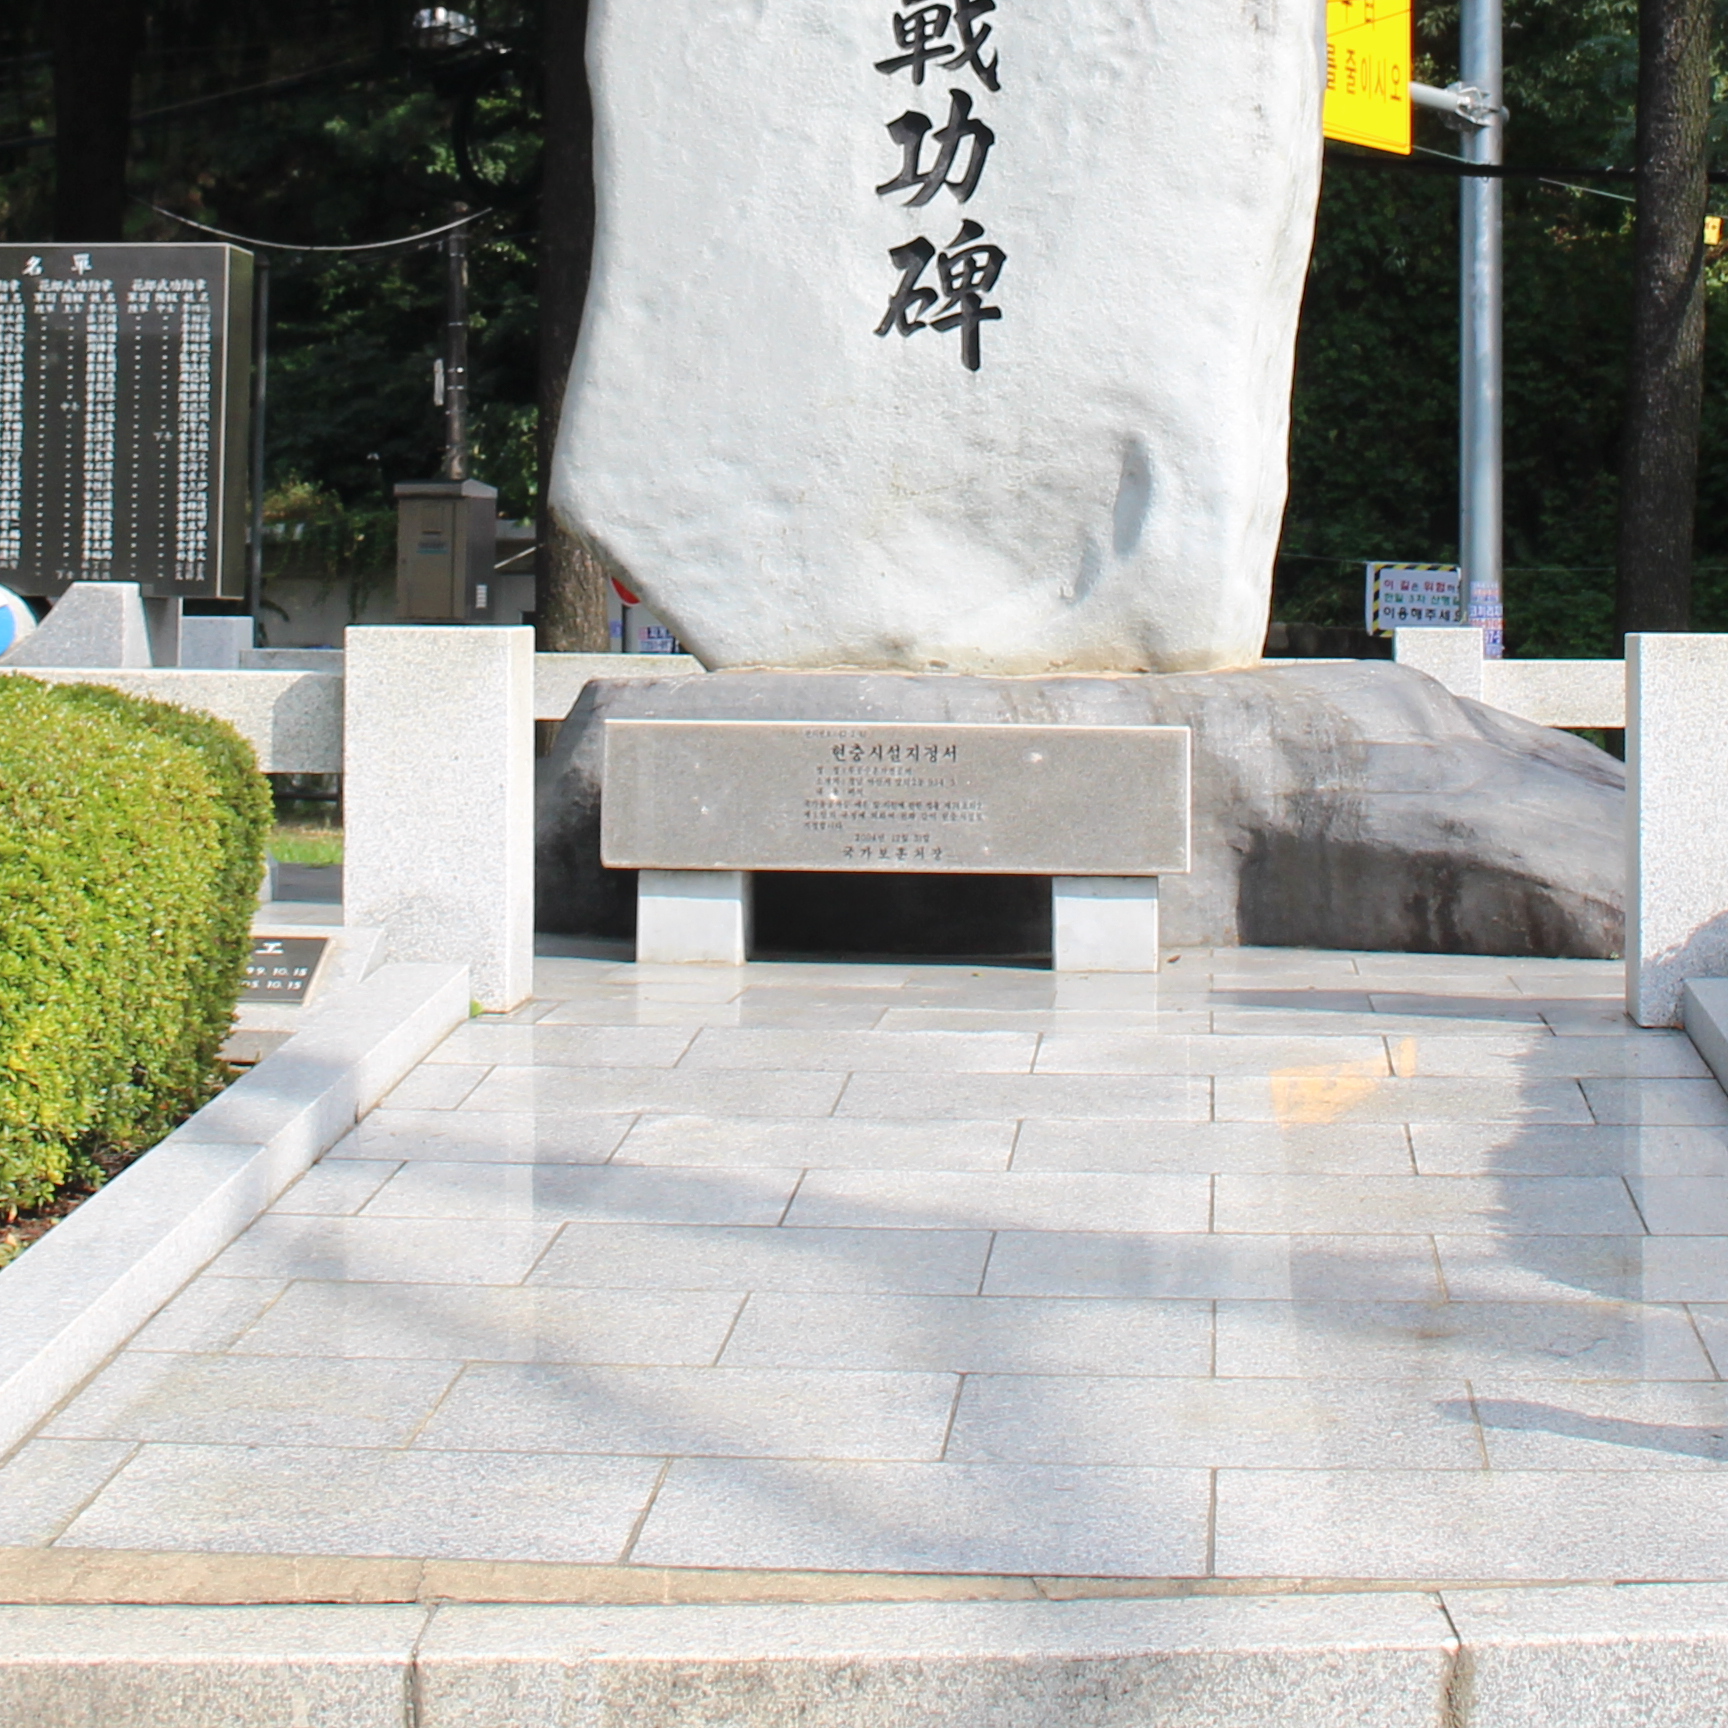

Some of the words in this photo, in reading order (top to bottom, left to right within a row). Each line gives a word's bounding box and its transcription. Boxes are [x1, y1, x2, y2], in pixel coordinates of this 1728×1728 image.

[1345, 48, 1402, 102] 줄이시오
[1384, 579, 1394, 590] 이
[1400, 580, 1419, 592] 길은
[1423, 581, 1461, 593] 위험하
[831, 744, 958, 762] 현충시설지정서
[293, 966, 309, 977] 15
[287, 980, 303, 990] 15
